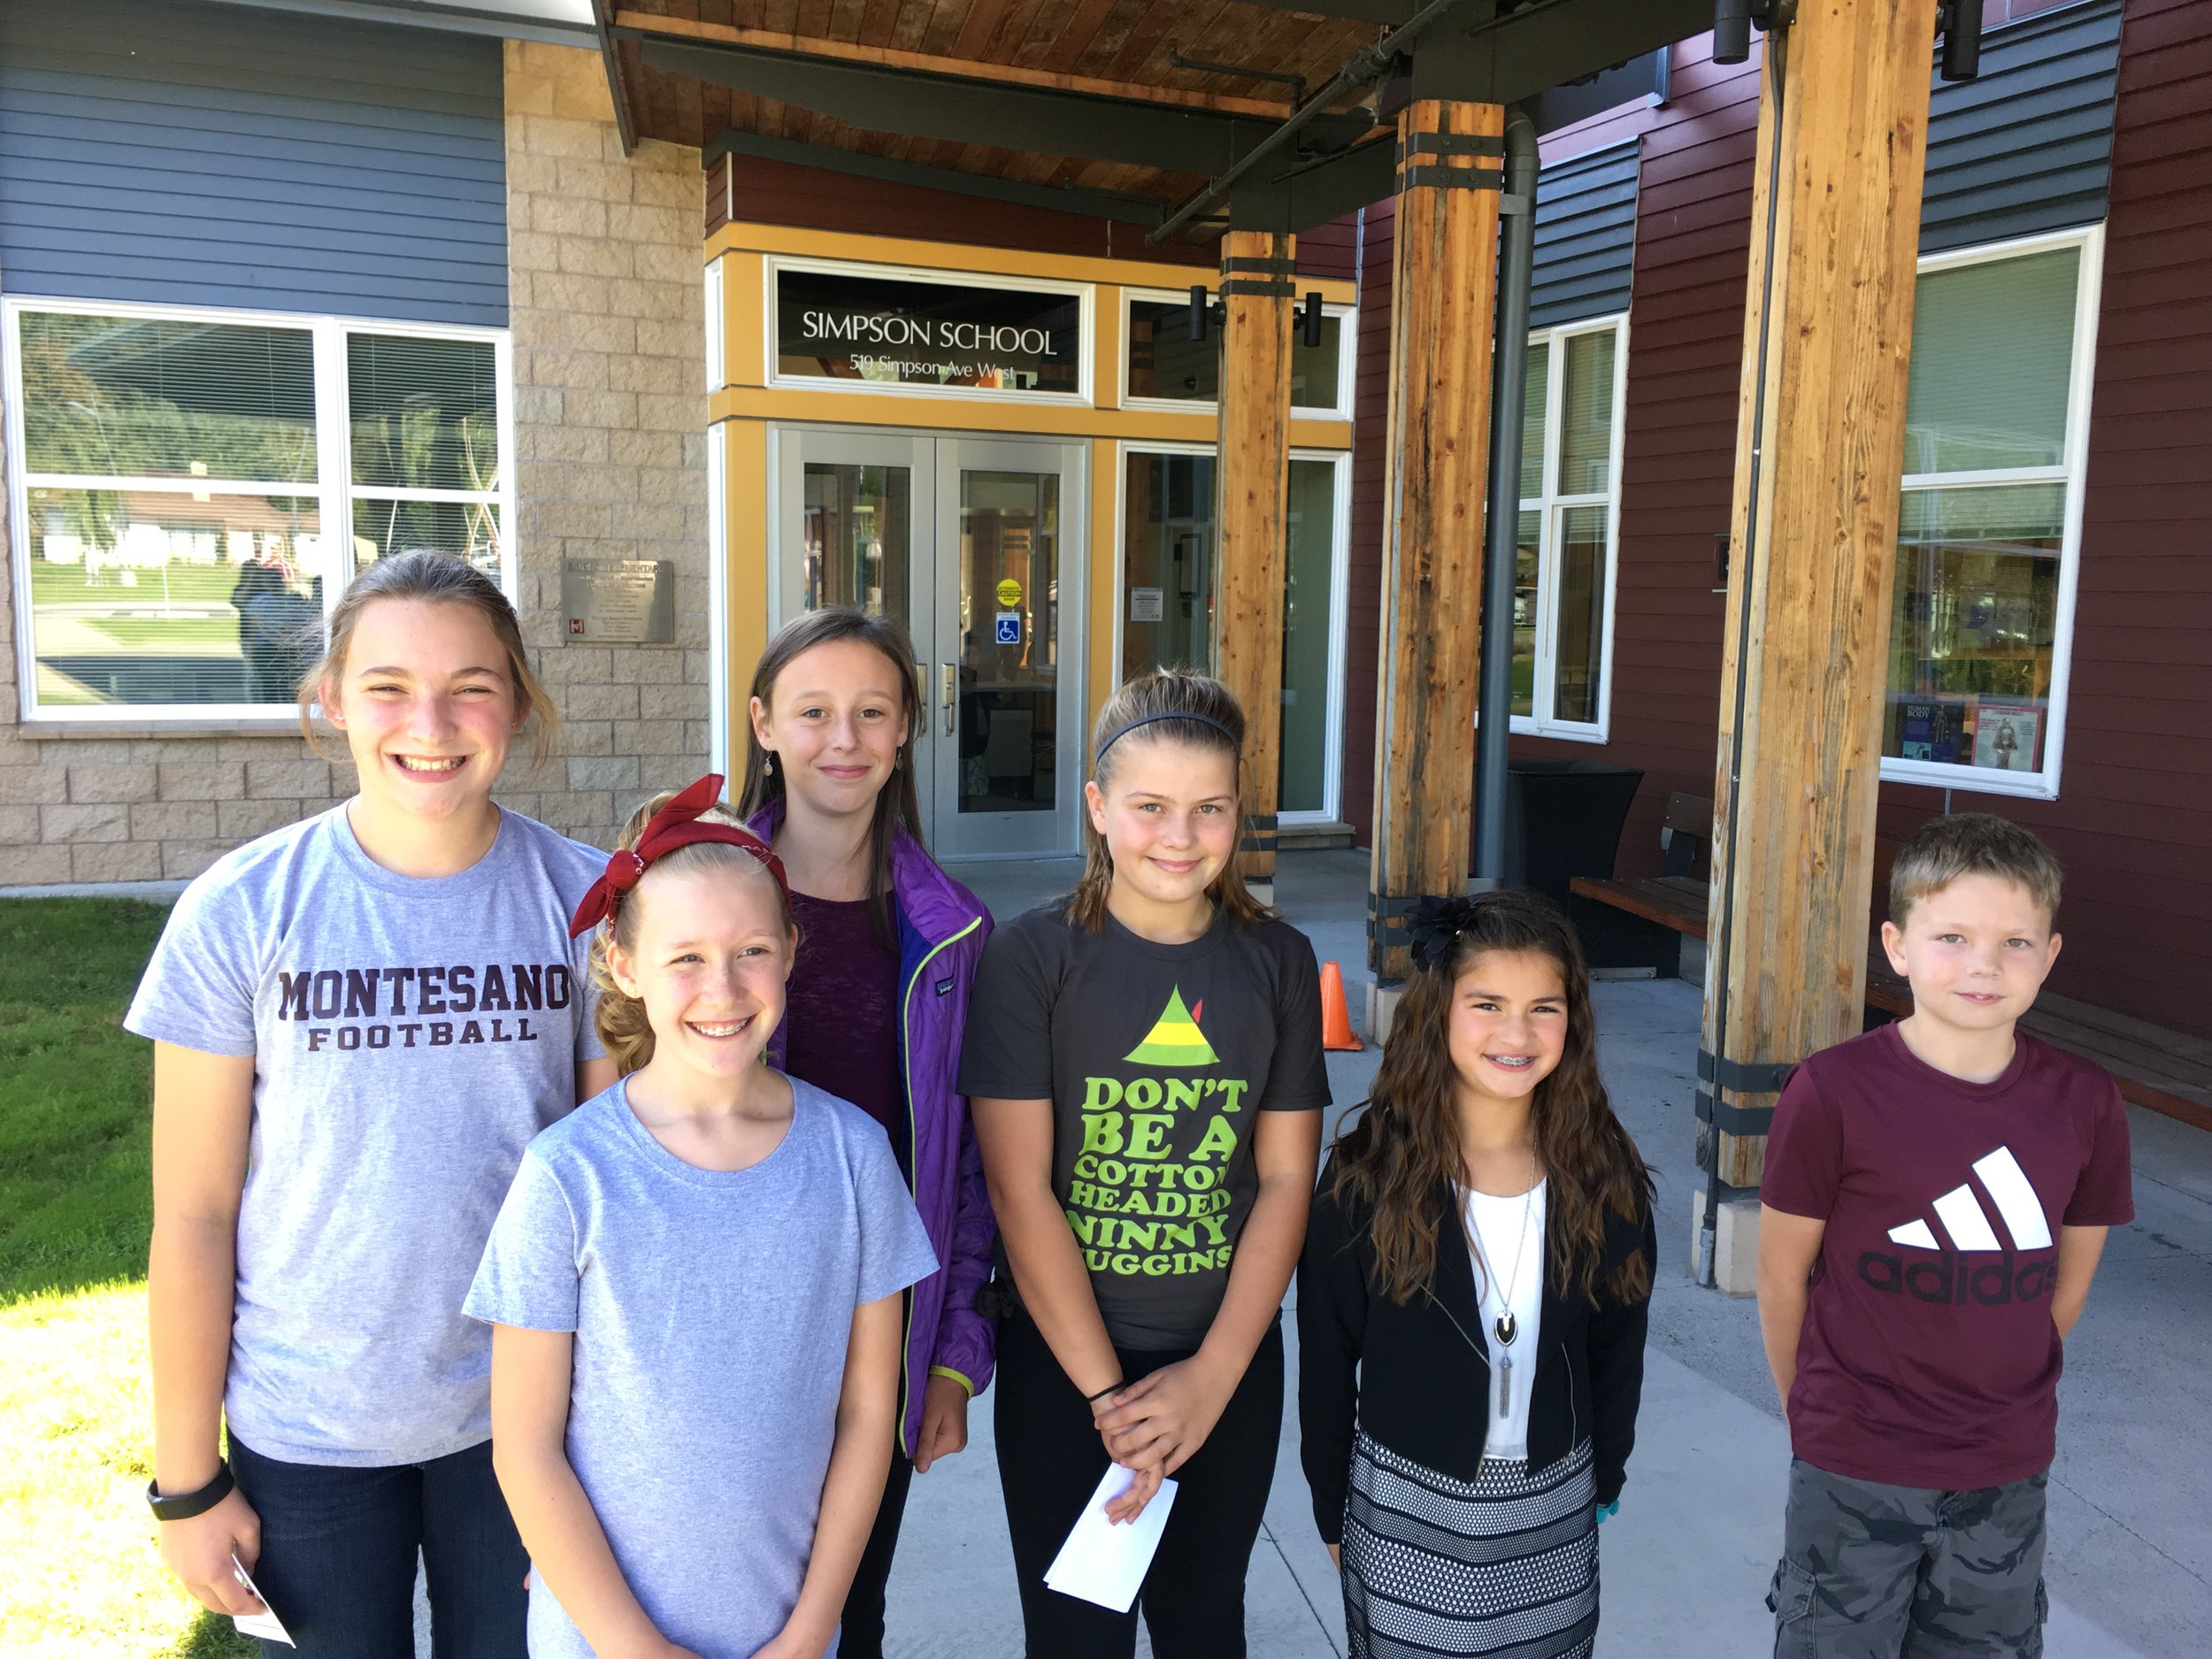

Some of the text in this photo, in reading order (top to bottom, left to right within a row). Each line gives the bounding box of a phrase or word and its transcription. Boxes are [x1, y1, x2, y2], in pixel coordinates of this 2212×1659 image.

[803, 311, 1057, 356] SIMPSON SCHOOL
[849, 354, 1015, 381] 519 Simpson Ave West
[278, 964, 570, 1020] MONTESANO
[308, 1018, 537, 1051] FOOTBALL
[1082, 1077, 1248, 1111] DON'T
[1079, 1111, 1237, 1161] BE A
[1068, 1180, 1232, 1217] HEADED
[1081, 1245, 1233, 1275] UGGINS
